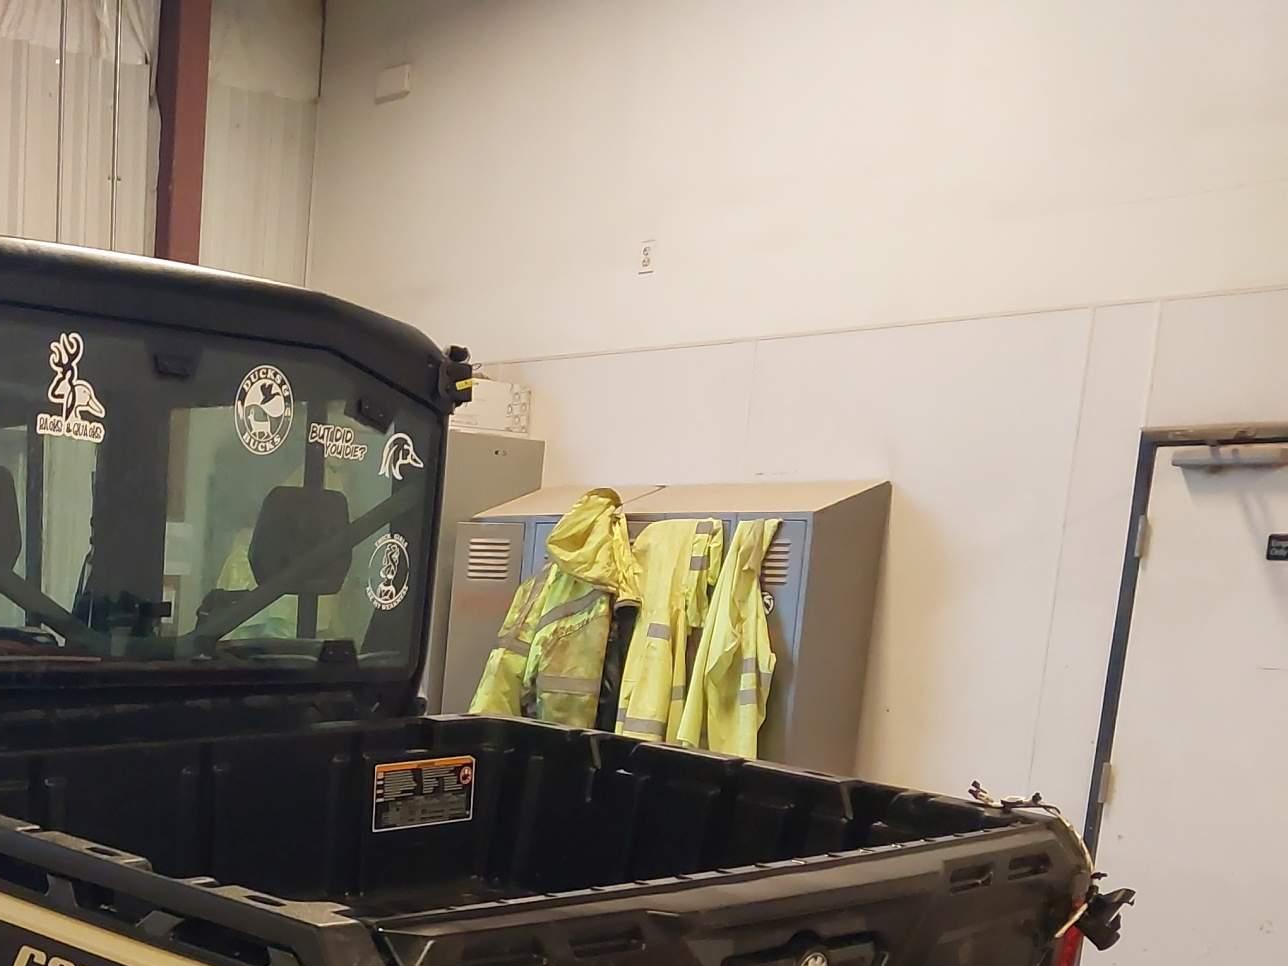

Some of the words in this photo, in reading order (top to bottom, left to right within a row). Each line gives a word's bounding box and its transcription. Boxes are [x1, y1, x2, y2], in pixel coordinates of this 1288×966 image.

[243, 368, 282, 392] DUCKS
[242, 432, 281, 452] BUCKS
[310, 424, 333, 441] BUT
[333, 427, 353, 444] DID
[324, 443, 343, 456] YOU
[344, 444, 366, 459] DIE?
